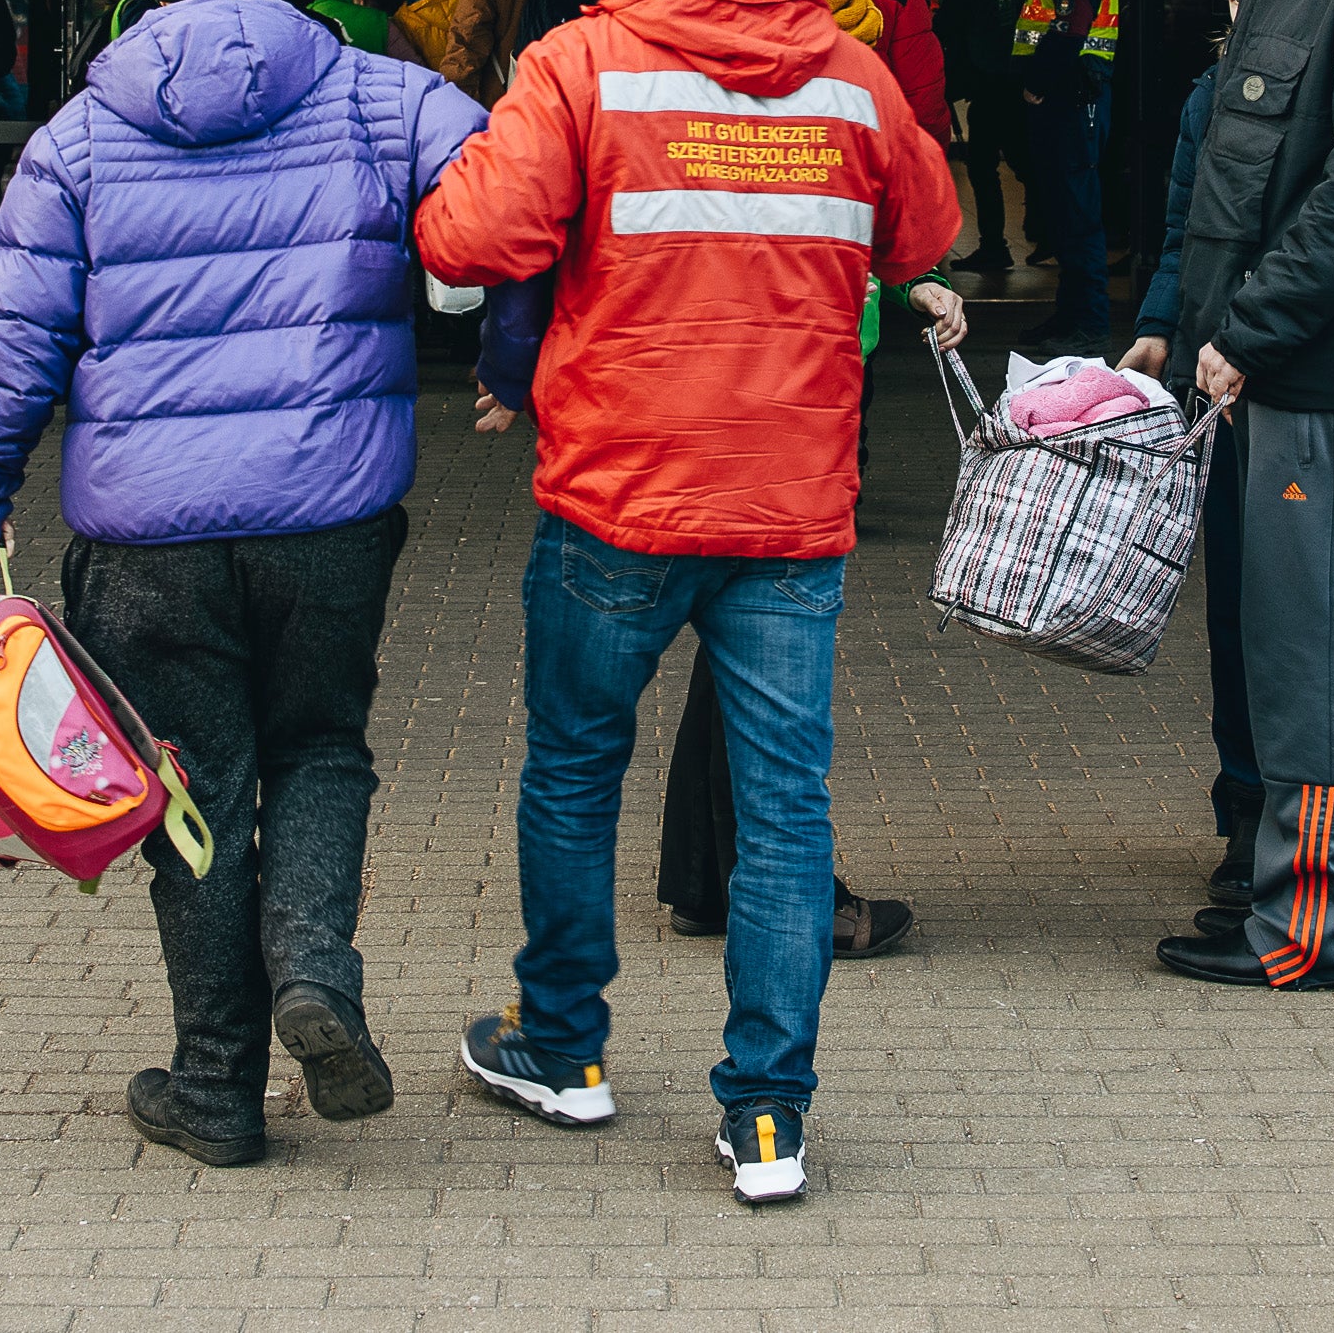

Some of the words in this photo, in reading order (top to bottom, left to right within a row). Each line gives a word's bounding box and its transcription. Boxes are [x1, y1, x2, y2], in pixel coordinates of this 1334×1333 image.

[687, 121, 713, 139] HIT
[715, 122, 828, 143] GYÜLEKEZETE
[667, 142, 843, 166] SZERETETSZOLGÁLATA
[686, 161, 829, 182] NYÍREGYHÁZA-OROS
[1282, 492, 1307, 501] adidas
